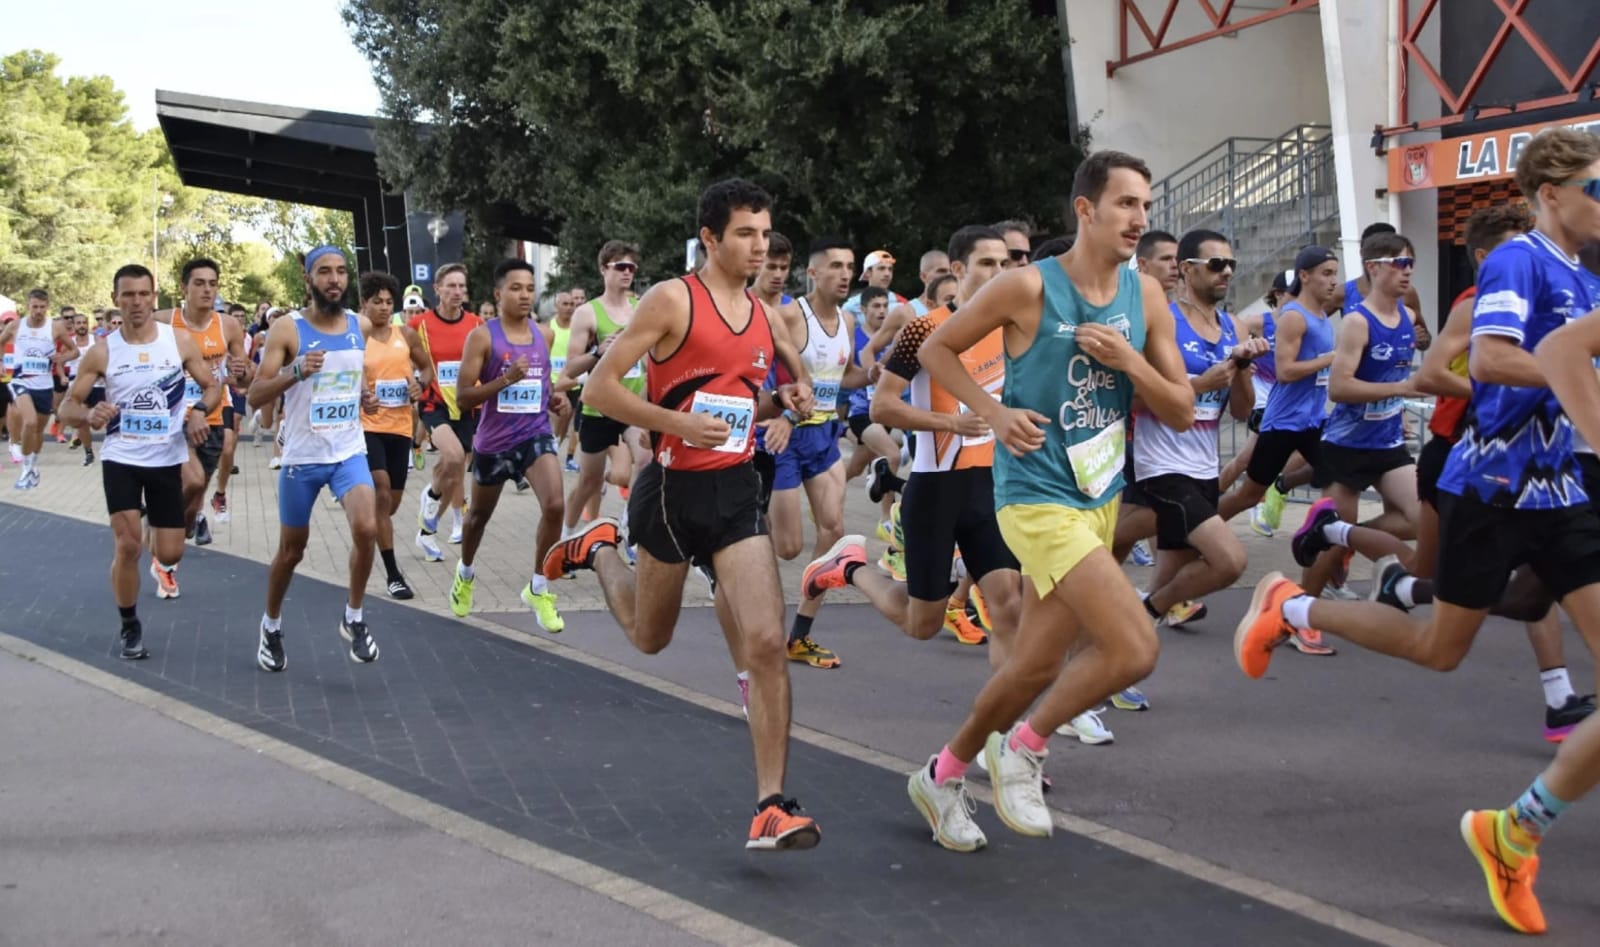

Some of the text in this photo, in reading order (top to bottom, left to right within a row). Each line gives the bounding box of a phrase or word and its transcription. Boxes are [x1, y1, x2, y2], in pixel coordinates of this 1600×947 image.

[1456, 137, 1500, 180] LA
[415, 264, 429, 280] B
[502, 389, 536, 401] 1147
[1074, 386, 1093, 409] &
[315, 403, 356, 419] 1207
[124, 418, 161, 432] 1134
